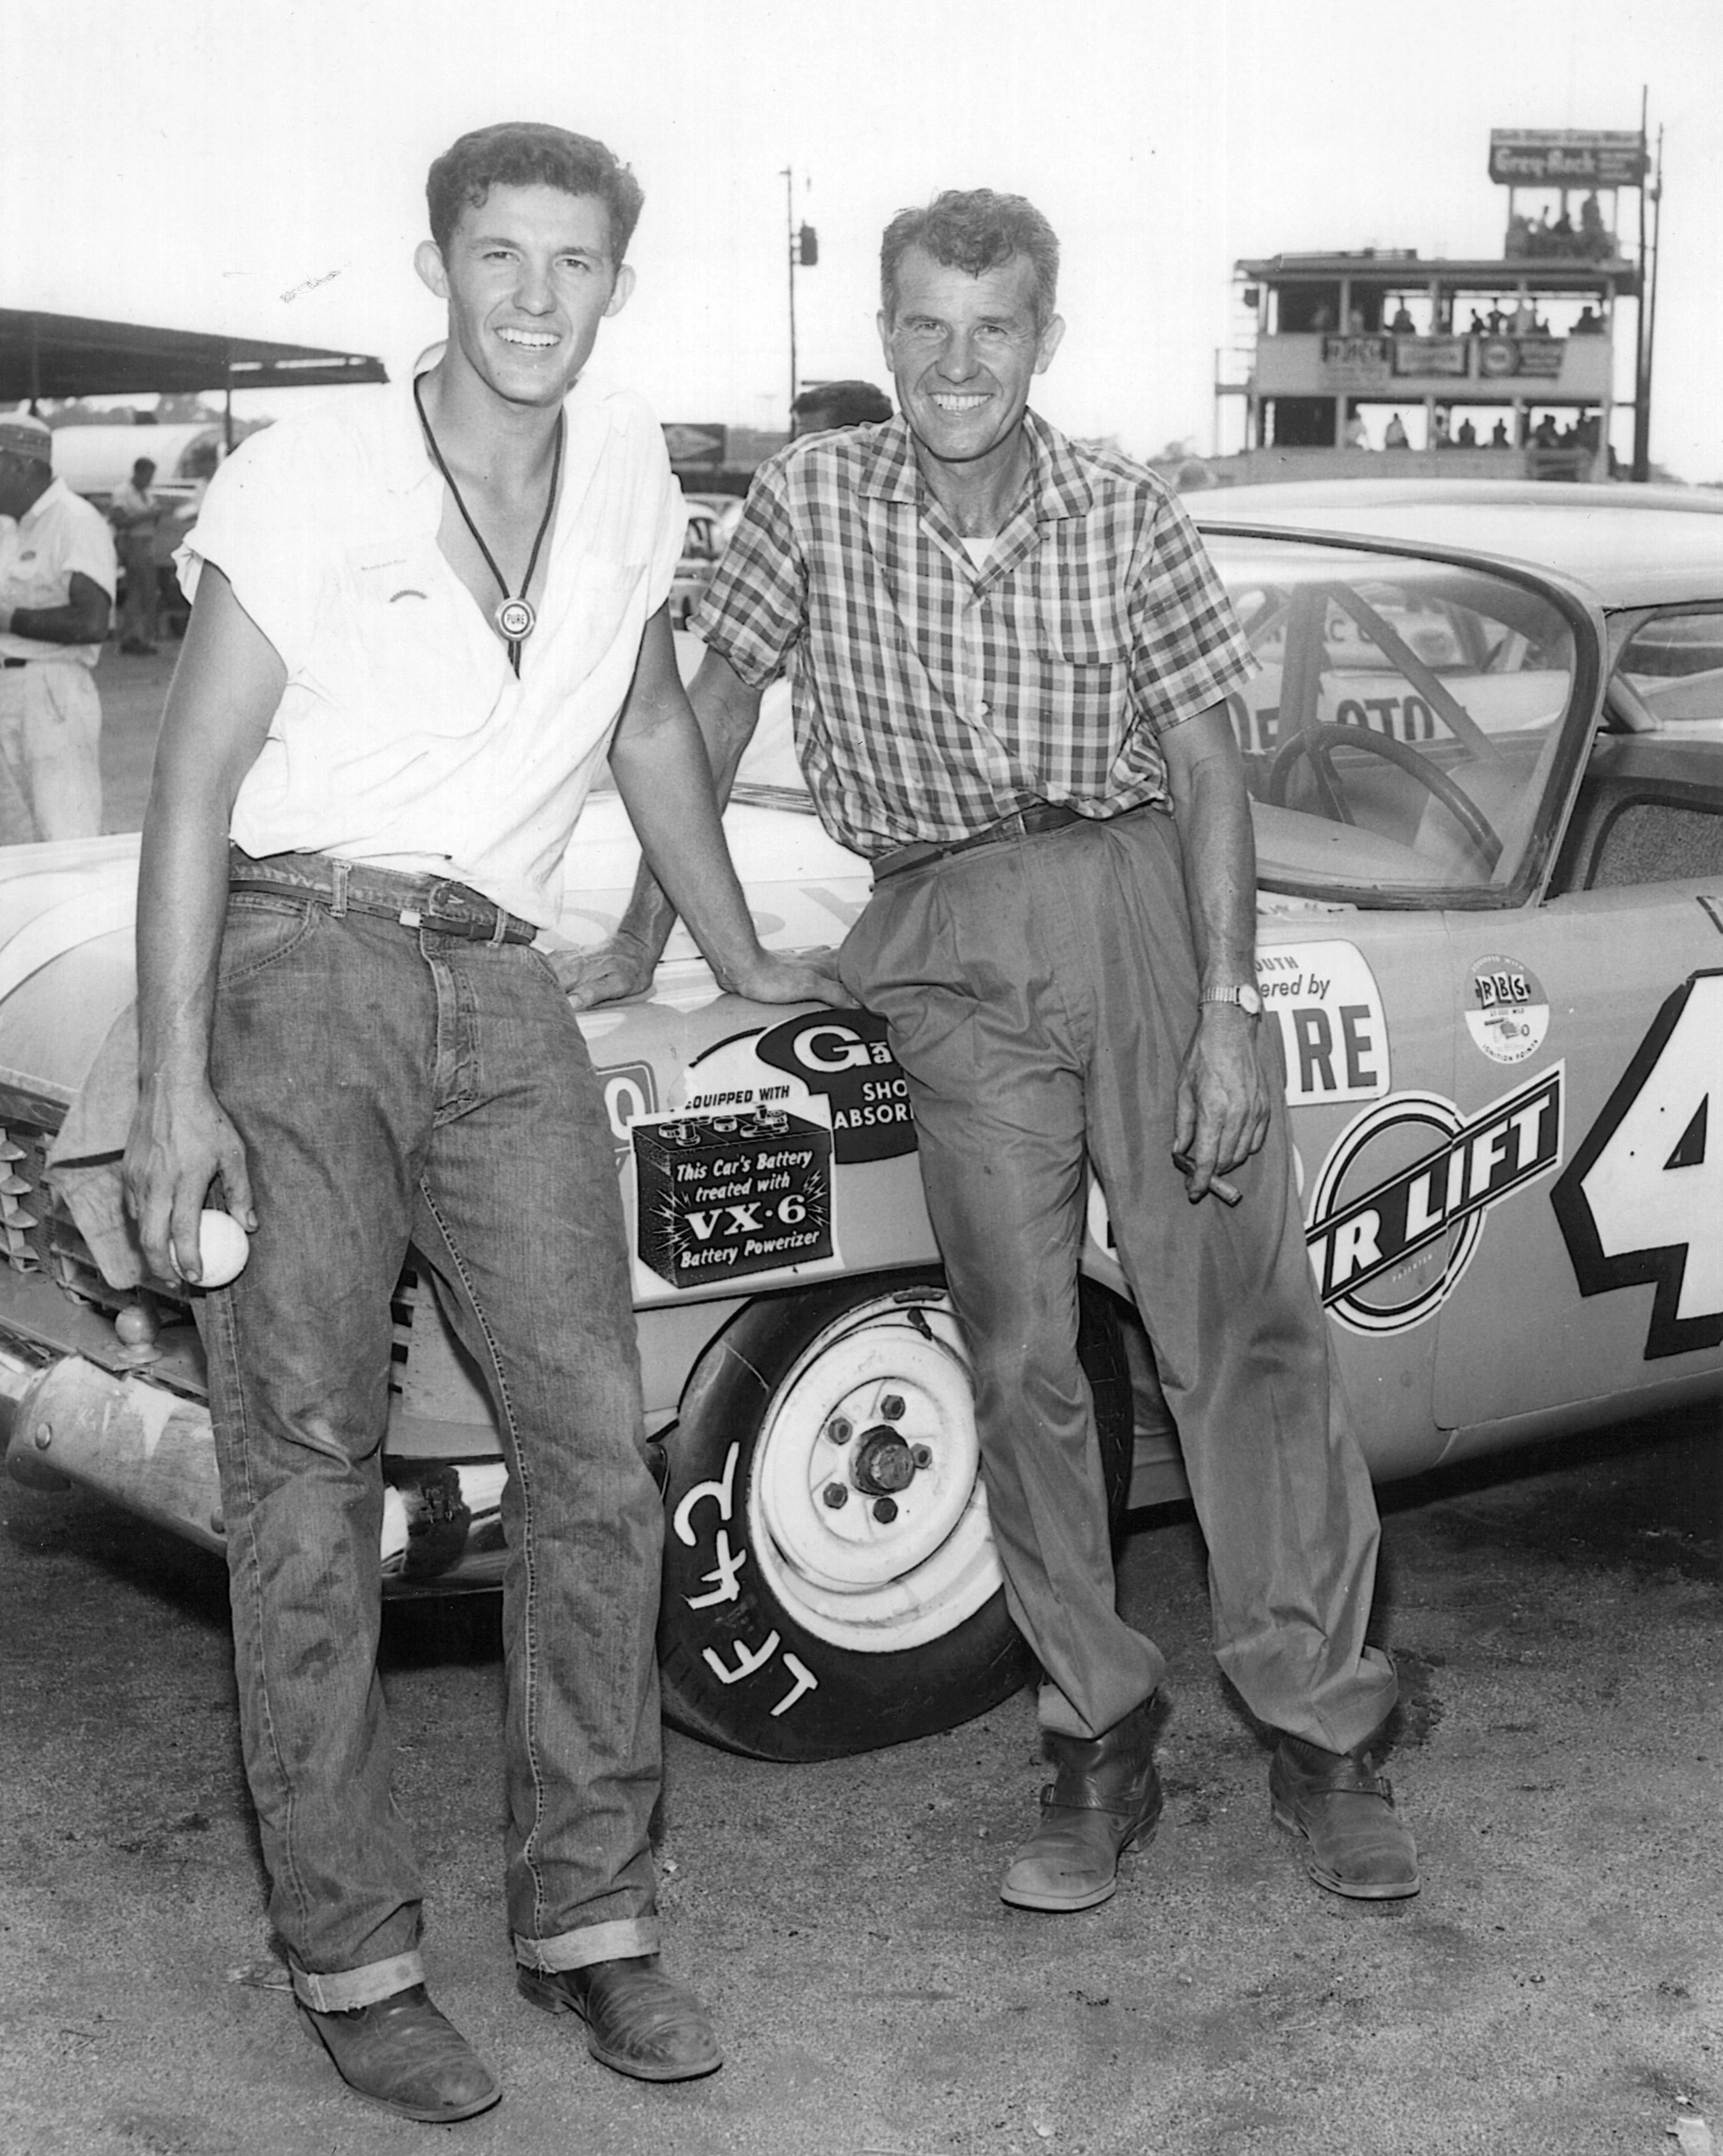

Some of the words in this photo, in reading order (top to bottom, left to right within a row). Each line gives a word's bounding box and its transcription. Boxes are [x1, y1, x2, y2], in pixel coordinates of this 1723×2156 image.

[1261, 974, 1303, 998] ered
[1308, 973, 1331, 1000] by
[1481, 975, 1526, 1000] RBS
[1266, 1004, 1377, 1093] RE
[759, 1085, 790, 1101] WITH
[833, 1102, 914, 1130] ABSOR
[676, 1164, 707, 1182] This
[712, 1154, 751, 1177] Car's
[756, 1149, 813, 1170] Battery
[1406, 1094, 1550, 1242] LIFT
[695, 1180, 751, 1203] treated
[756, 1174, 790, 1194] with
[680, 1244, 739, 1268] Battery
[744, 1230, 820, 1257] Powerizer
